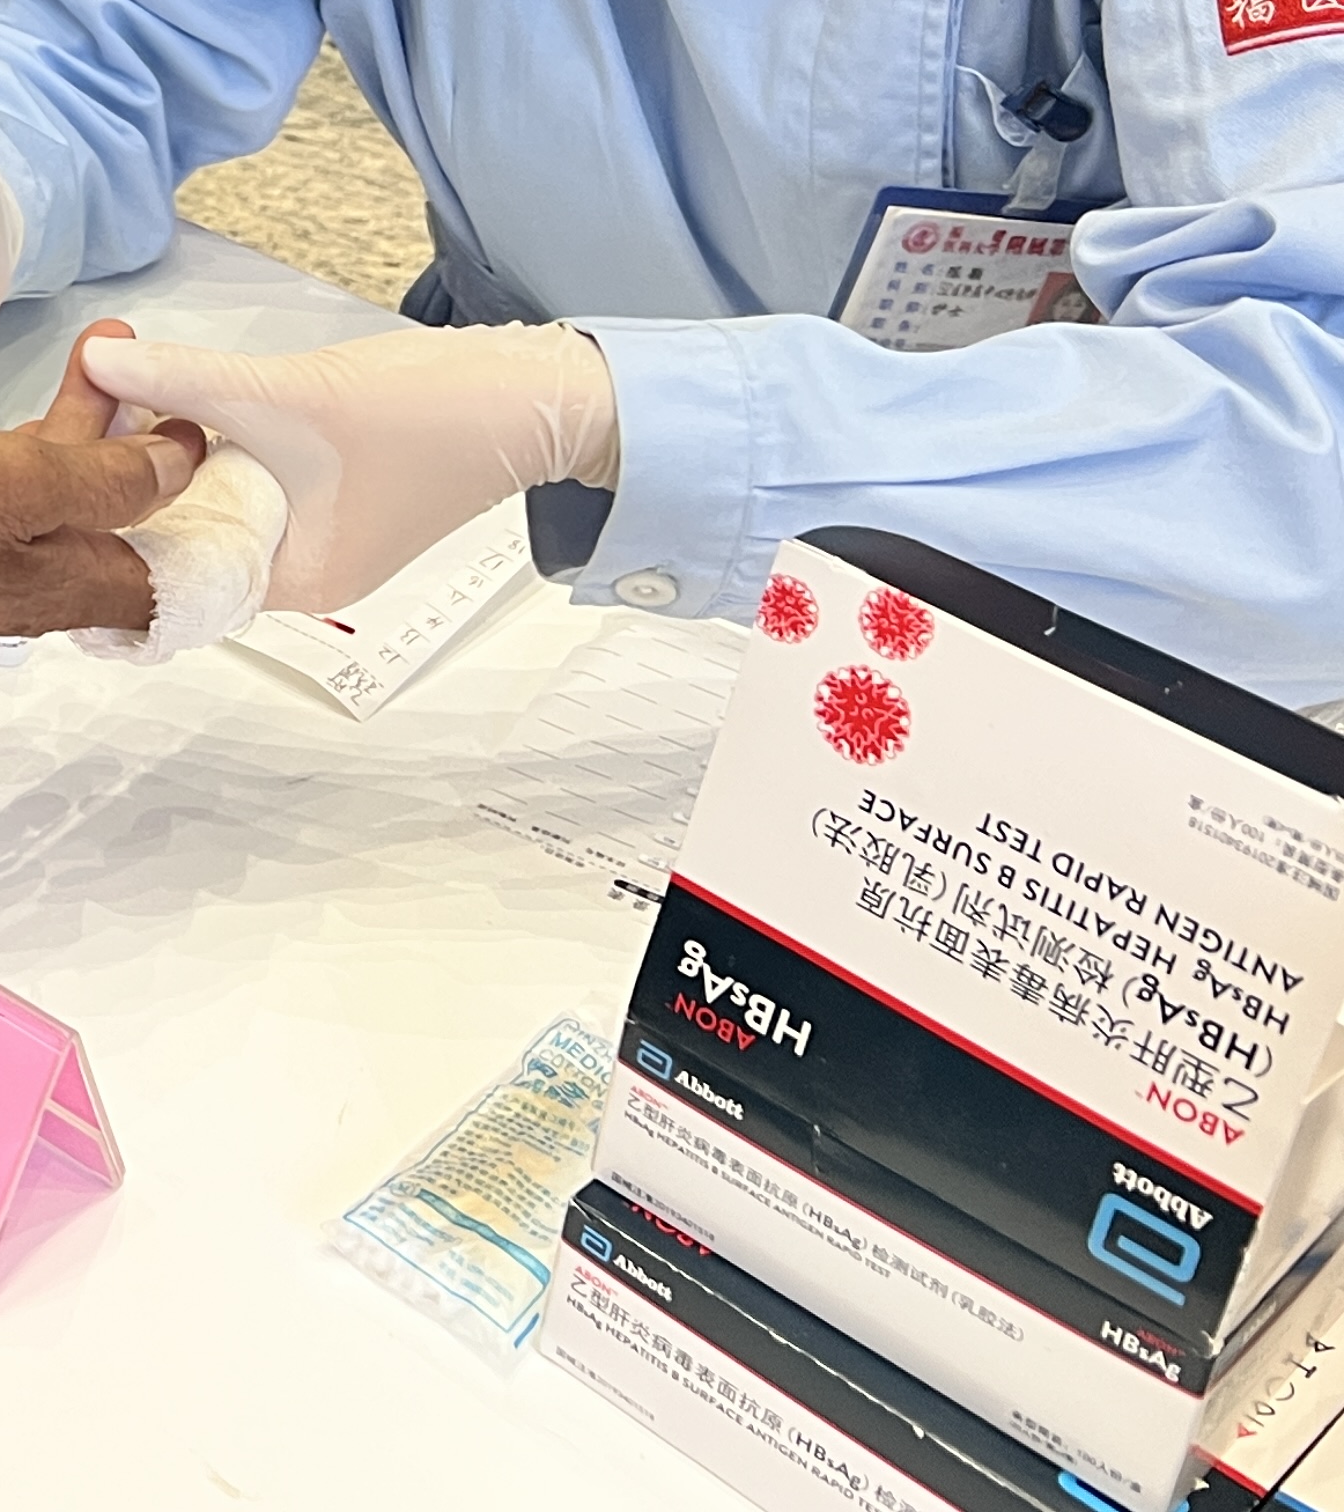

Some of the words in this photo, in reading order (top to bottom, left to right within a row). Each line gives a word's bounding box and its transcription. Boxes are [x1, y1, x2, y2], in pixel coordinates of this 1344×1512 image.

[479, 551, 505, 570] 17
[379, 647, 401, 664] 12
[858, 790, 991, 874] SURFACE
[976, 813, 1041, 863] TEST
[998, 865, 1016, 889] B
[1052, 853, 1147, 915] RAPID
[1023, 879, 1176, 974] HEPATITIS
[1155, 904, 1303, 992] ANTIGEN
[678, 940, 811, 1057] HBsAg
[856, 877, 1258, 1121] 乙型肝炎病毒表面抗原
[1193, 959, 1289, 1035] HBsAg
[674, 1071, 743, 1120] Abbott
[653, 1132, 709, 1169] HEPATITIS
[722, 1171, 779, 1211] SURFACE
[777, 1208, 828, 1239] ANTIGEN
[827, 1236, 862, 1261] RAPID
[865, 1258, 890, 1278] TEST
[1113, 1163, 1213, 1229] Abbott
[613, 1255, 672, 1301] Abbott
[1101, 1321, 1181, 1382] HBsAg
[606, 1324, 668, 1373] HEPATITIS
[683, 1378, 742, 1425] SURFACE
[746, 1424, 807, 1469] ANTIGEN
[811, 1466, 858, 1499] RAPID
